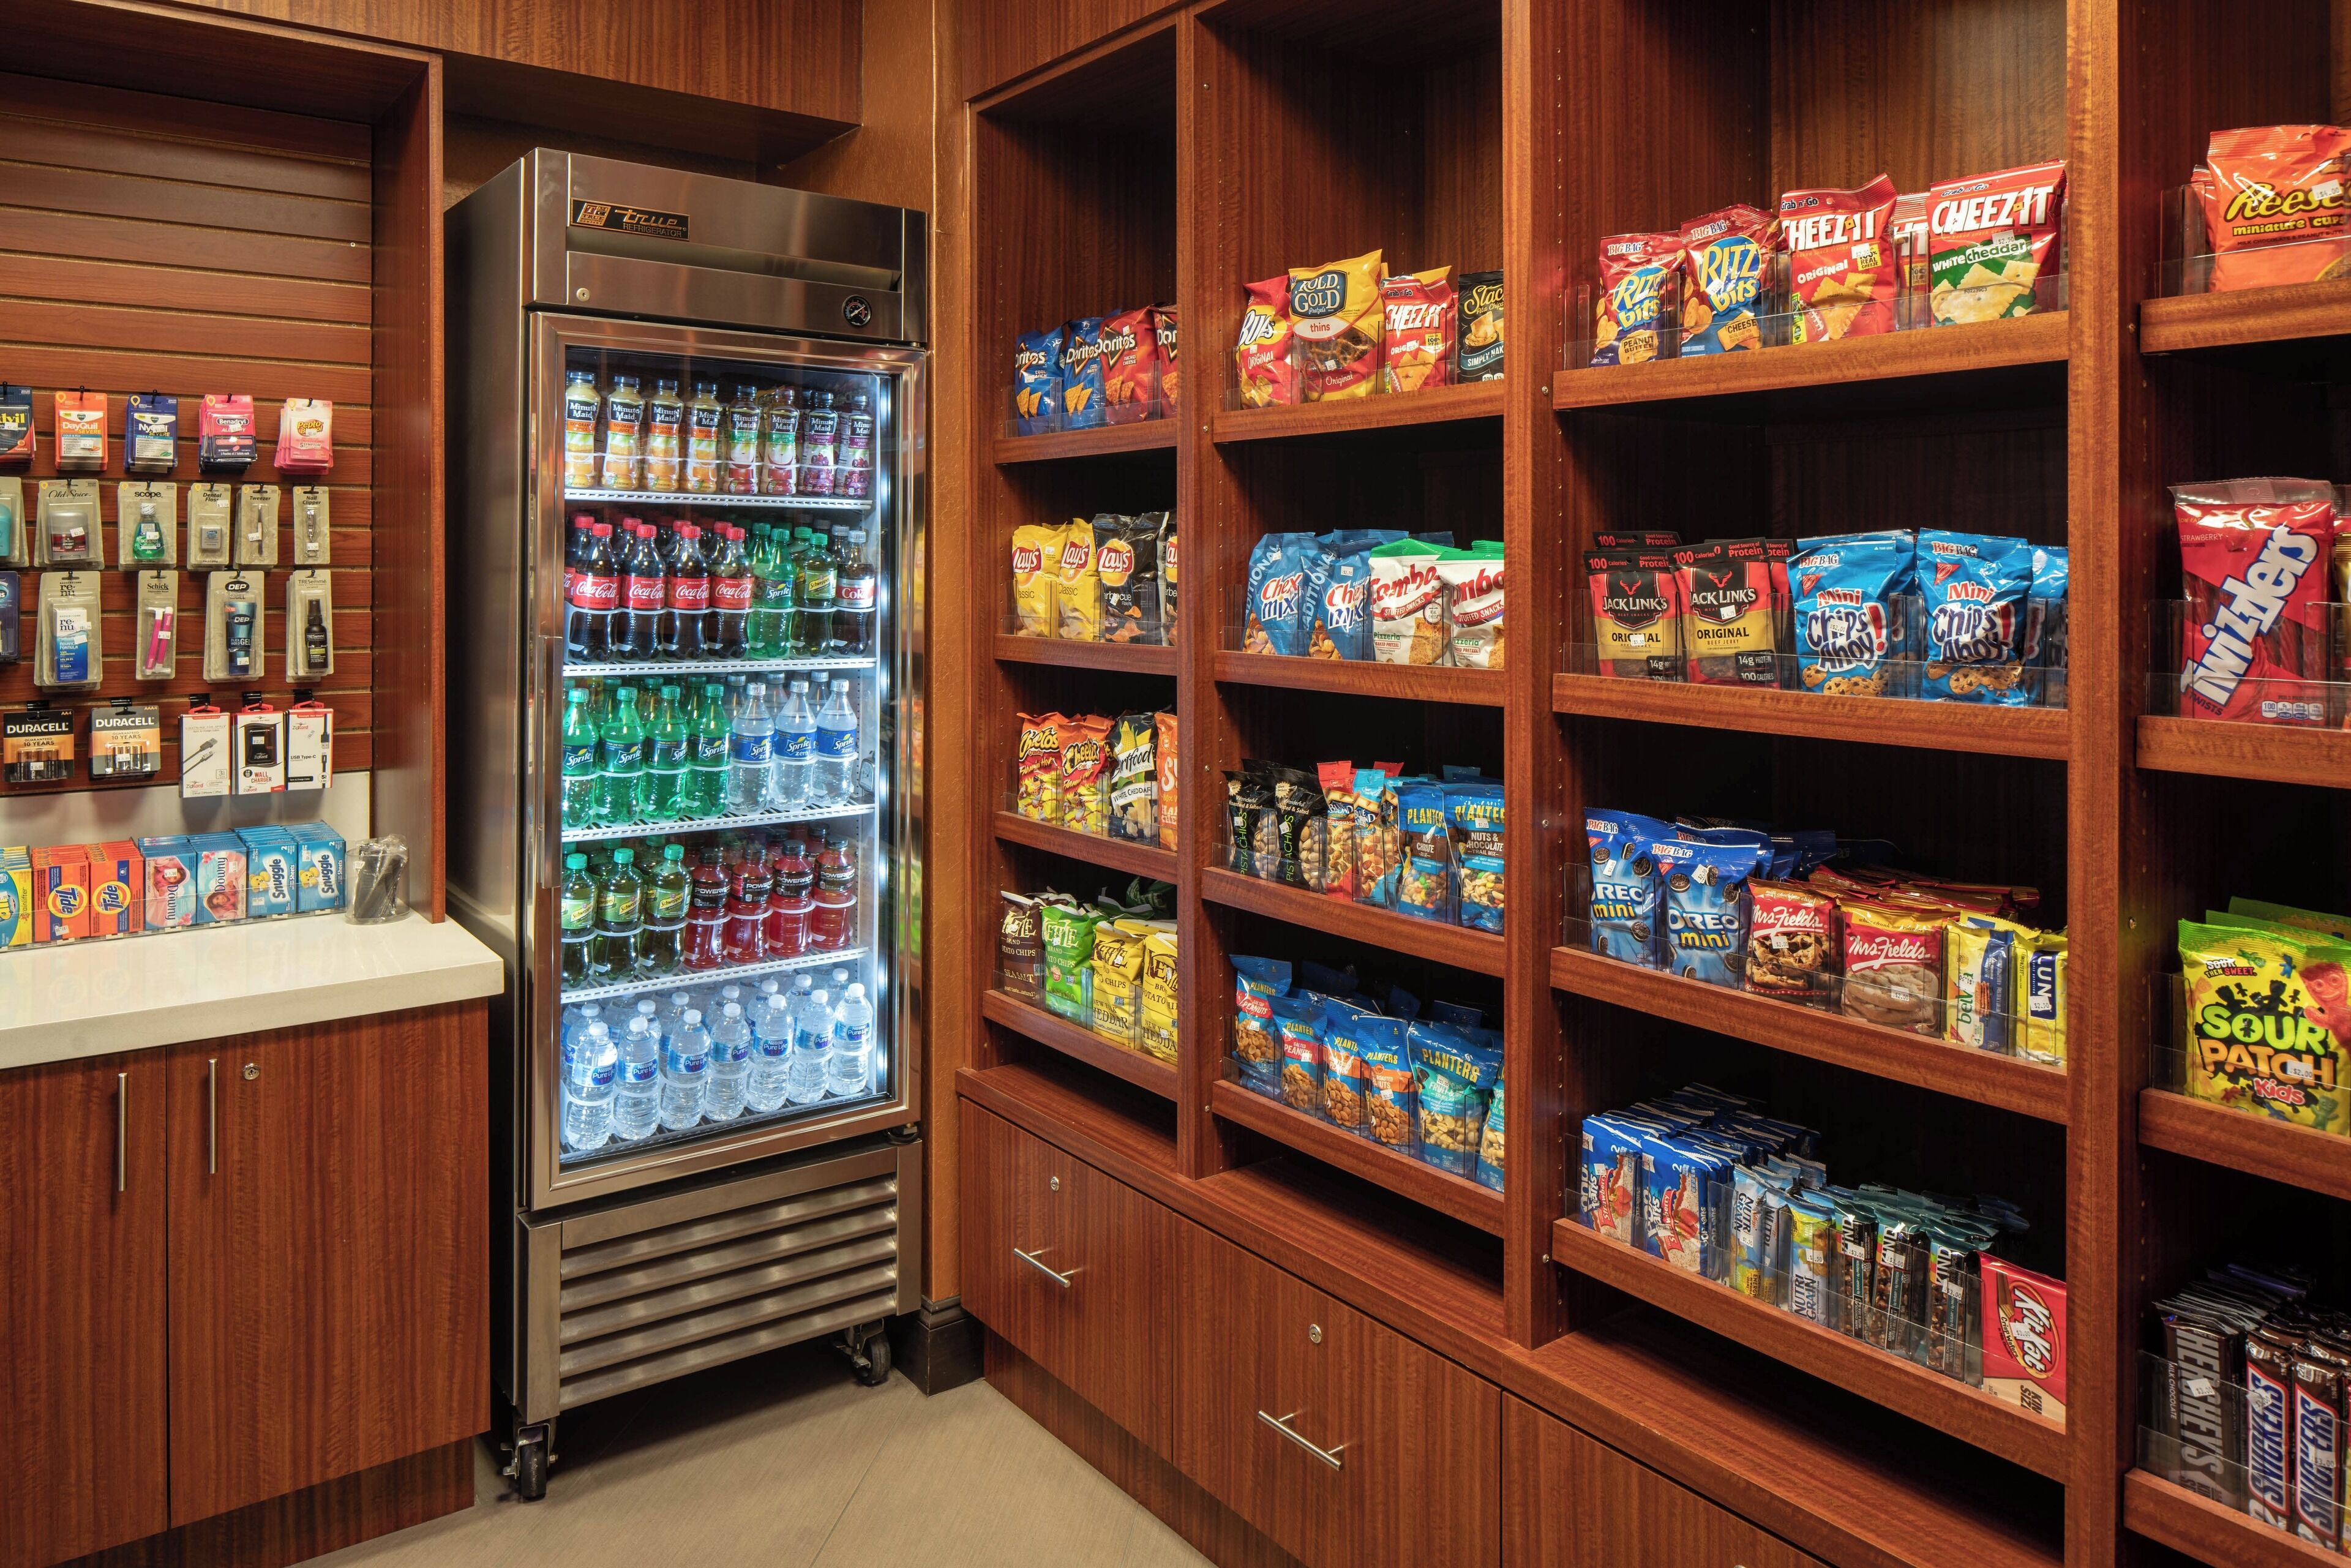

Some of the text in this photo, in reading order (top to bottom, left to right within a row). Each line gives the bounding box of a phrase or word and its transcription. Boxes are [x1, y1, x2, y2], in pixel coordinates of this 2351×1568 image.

[623, 223, 681, 238] REFRIGERATOR
[2233, 215, 2345, 236] miniature cups
[1997, 236, 2015, 244] $2.50
[2253, 236, 2290, 244] CHOCOLATE
[1608, 242, 1642, 255] BIG BAG
[1967, 241, 2026, 263] cheddar
[1700, 243, 1759, 292] RITZ
[1294, 290, 1340, 313] GOLD
[1711, 278, 1757, 312] bits
[1619, 298, 1661, 329] bits
[1310, 323, 1330, 332] thins
[1727, 318, 1757, 334] CHEESE
[1623, 336, 1654, 348] PEANUT
[1624, 343, 1653, 354] BUTTER
[1066, 343, 1099, 363] Doritos
[1468, 354, 1488, 366] SIMPLY
[1325, 371, 1354, 386] Original
[570, 402, 596, 411] Minute
[613, 404, 640, 413] Minute
[62, 421, 98, 430] DayQuil
[1598, 536, 1615, 547] 100
[1061, 544, 1088, 569] Lay's
[1728, 547, 1763, 558] Protein
[1013, 549, 1040, 573] Lay's
[1098, 550, 1131, 572] Lay's
[1799, 554, 1838, 568] BIG BAG
[576, 582, 617, 598] Coca-Cola
[767, 588, 790, 599] Sprite
[1059, 583, 1078, 596] Classic
[1261, 572, 1304, 601] Chex
[1603, 597, 1668, 611] JACK LINK'S
[1817, 589, 1862, 607] Mini
[1261, 593, 1299, 621] mix
[1384, 597, 1425, 617] STUFFED SNACKS
[1373, 631, 1401, 641] Pizzeria
[1697, 627, 1749, 639] ORIGINAL
[1738, 656, 1754, 666] 14g
[2189, 692, 2224, 716] TWISTS
[7, 722, 69, 734] DURACELL
[96, 716, 155, 727] DURACELL
[704, 744, 726, 756] Sprite
[787, 740, 810, 751] Sprite
[834, 738, 854, 748] Sprite
[566, 751, 591, 765] Sprite
[619, 749, 641, 763] Sprite
[1471, 832, 1491, 841] NUTS
[1467, 841, 1504, 852] CHOCOLATE
[214, 857, 228, 893] Downy
[272, 858, 286, 899] Snuggle
[321, 853, 336, 895] Snuggle
[54, 887, 77, 915] Tide
[99, 884, 124, 912] Tide
[165, 884, 179, 921] Downy
[1594, 901, 1635, 918] mini
[1668, 909, 1739, 931] OREO
[1775, 906, 1820, 929] Fields
[1681, 930, 1730, 948] mini
[1849, 935, 1930, 961] Mrs. Fields
[2207, 958, 2237, 969] SOUR
[1017, 972, 1033, 982] SALT
[2205, 969, 2224, 978] THEN
[1104, 978, 1126, 989] CHIPS
[1250, 982, 1276, 996] PLANTERS
[1894, 992, 1909, 1000] $2.00
[1243, 1001, 1267, 1015] PEANUTS
[2203, 1005, 2327, 1056] SOUR
[1366, 1051, 1398, 1065] PLANTERS
[1422, 1048, 1479, 1083] PLANTERS
[2199, 1039, 2334, 1090] PATCH
[2293, 1067, 2312, 1078] $2.00
[2254, 1078, 2306, 1105] Kids
[1794, 1274, 1806, 1317] NUTRI
[1805, 1276, 1817, 1321] GRAIN
[2014, 1288, 2050, 1335] Kit
[2001, 1316, 2019, 1358] Crisp Wafers
[2168, 1374, 2178, 1420] CHOCOLATE
